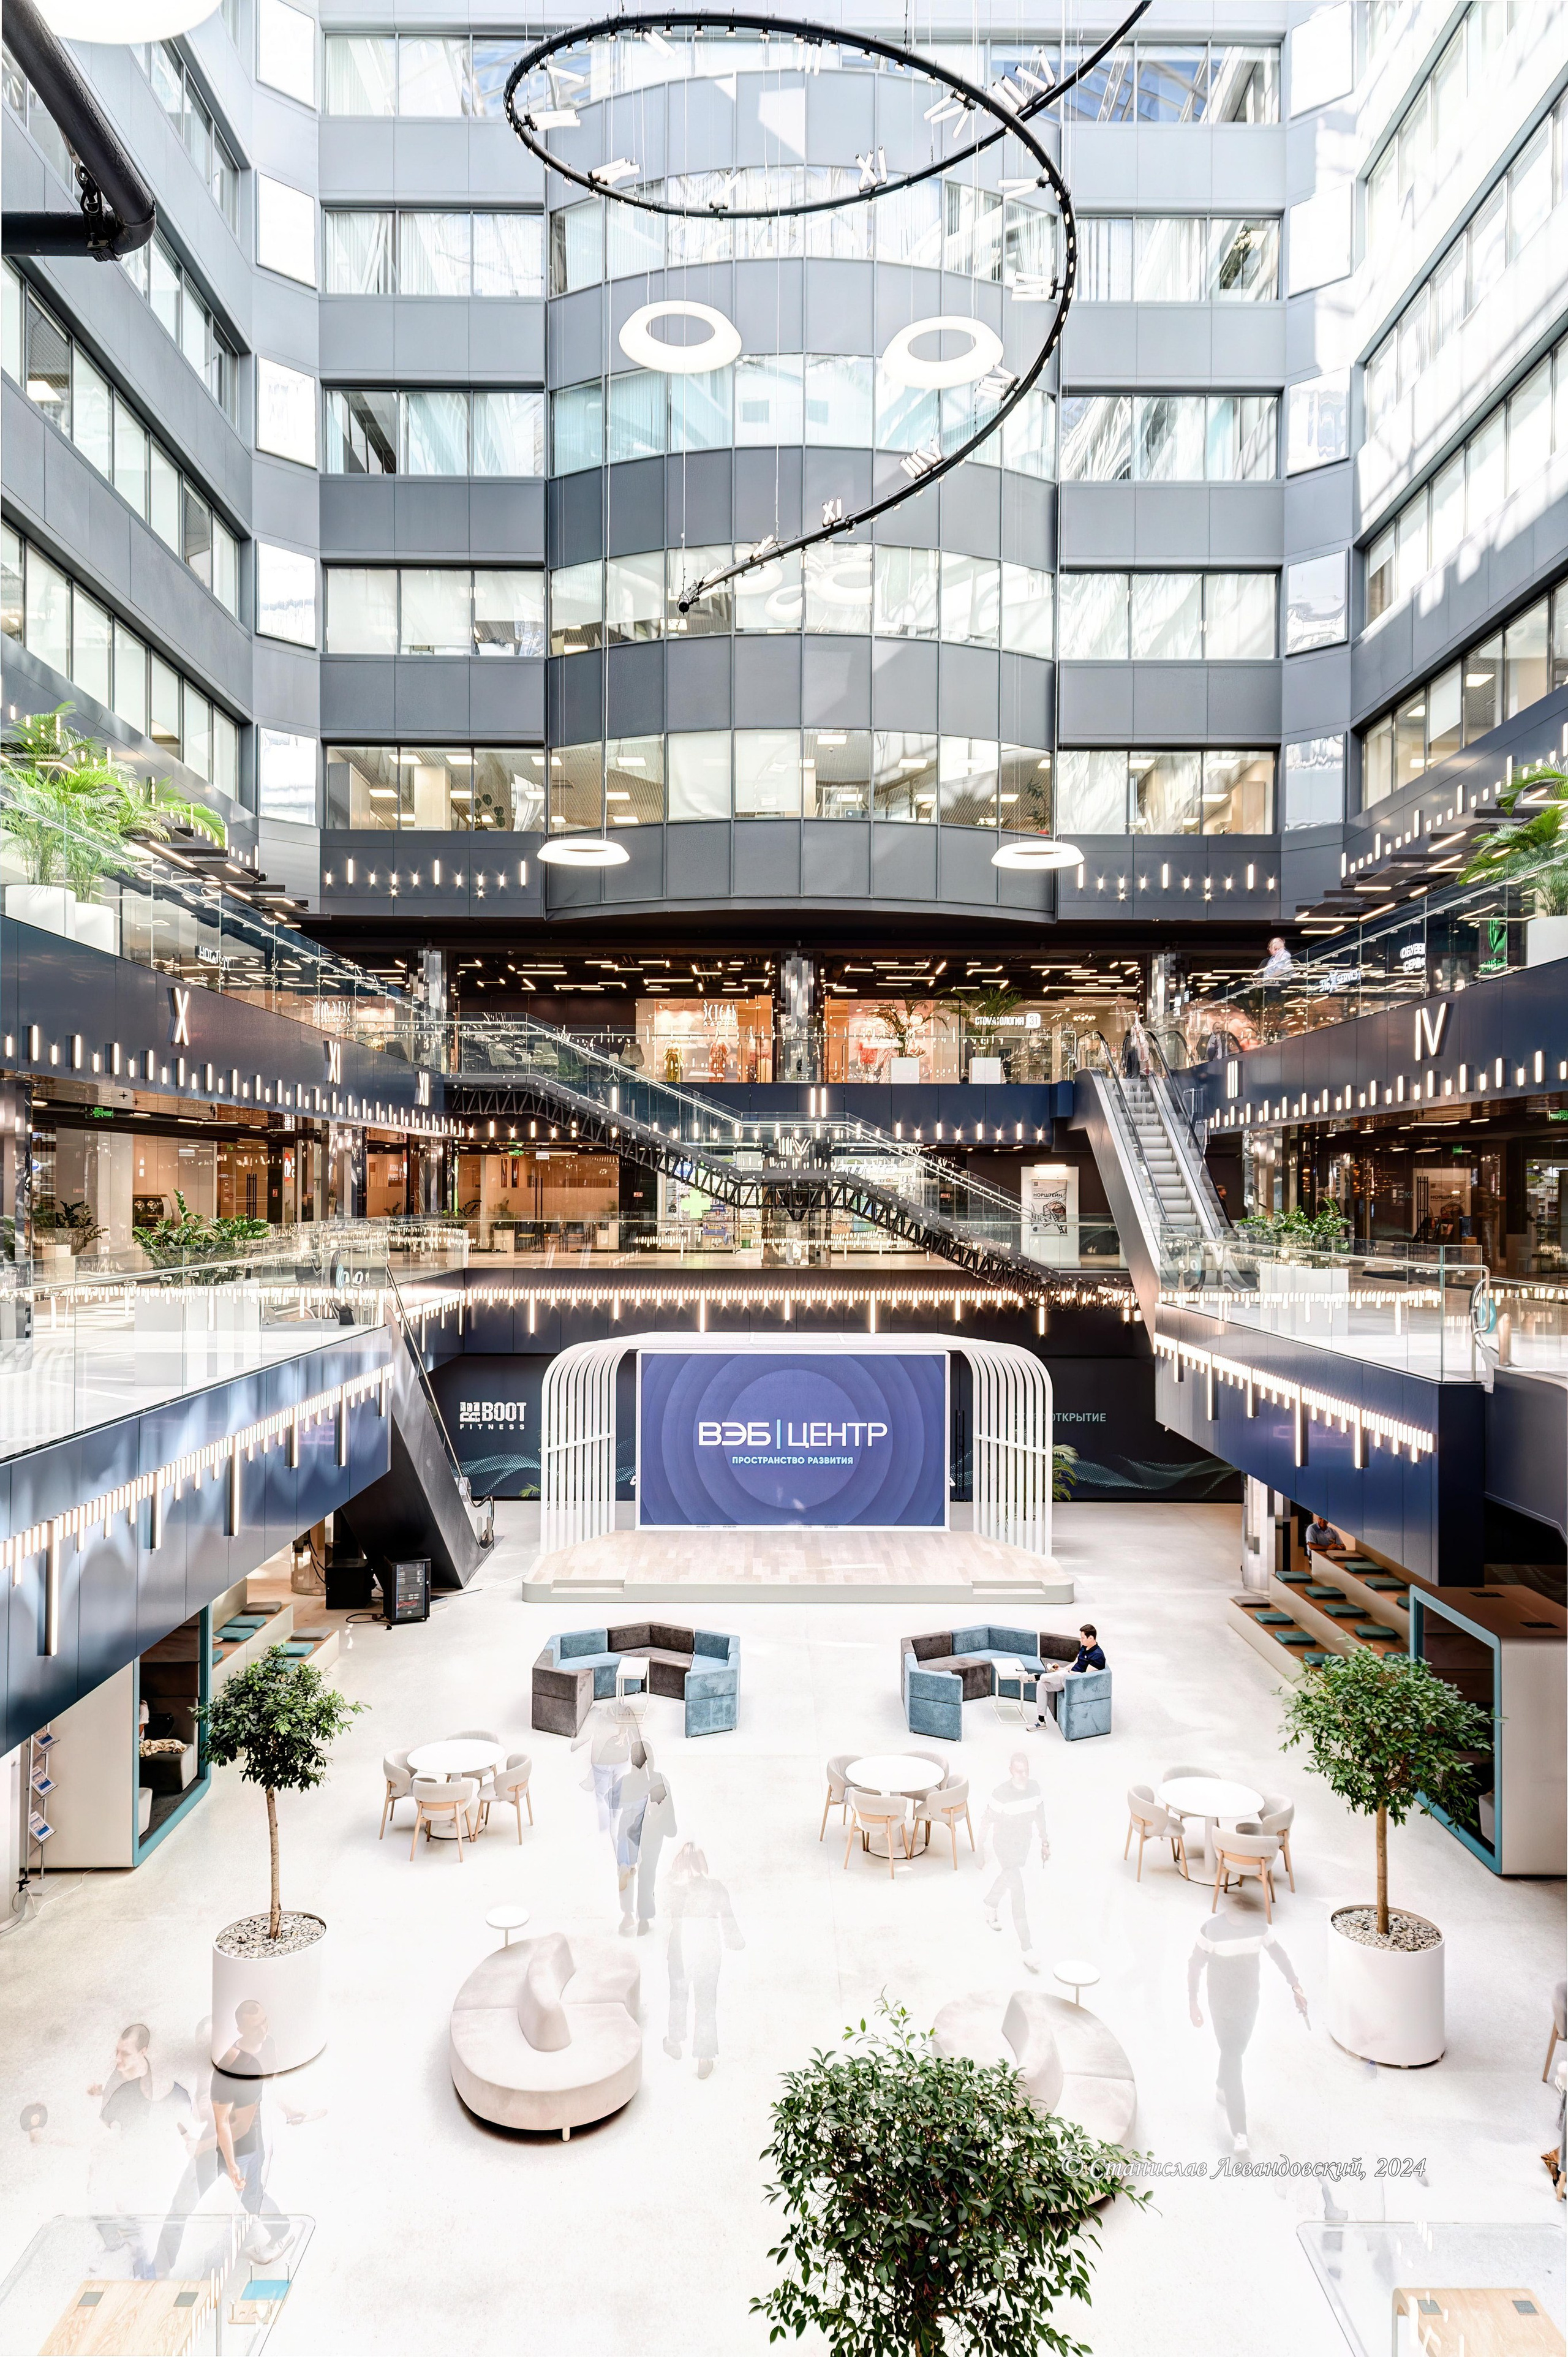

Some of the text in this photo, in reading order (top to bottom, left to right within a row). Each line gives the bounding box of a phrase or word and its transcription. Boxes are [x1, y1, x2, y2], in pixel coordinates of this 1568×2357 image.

[1415, 1002, 1446, 1060] IV
[328, 1040, 341, 1084] XI
[698, 1422, 888, 1449] ВЭБ ЦЕНТР
[732, 1456, 853, 1465] ПРОСТРАНСТВО РАЗВИТИЯ
